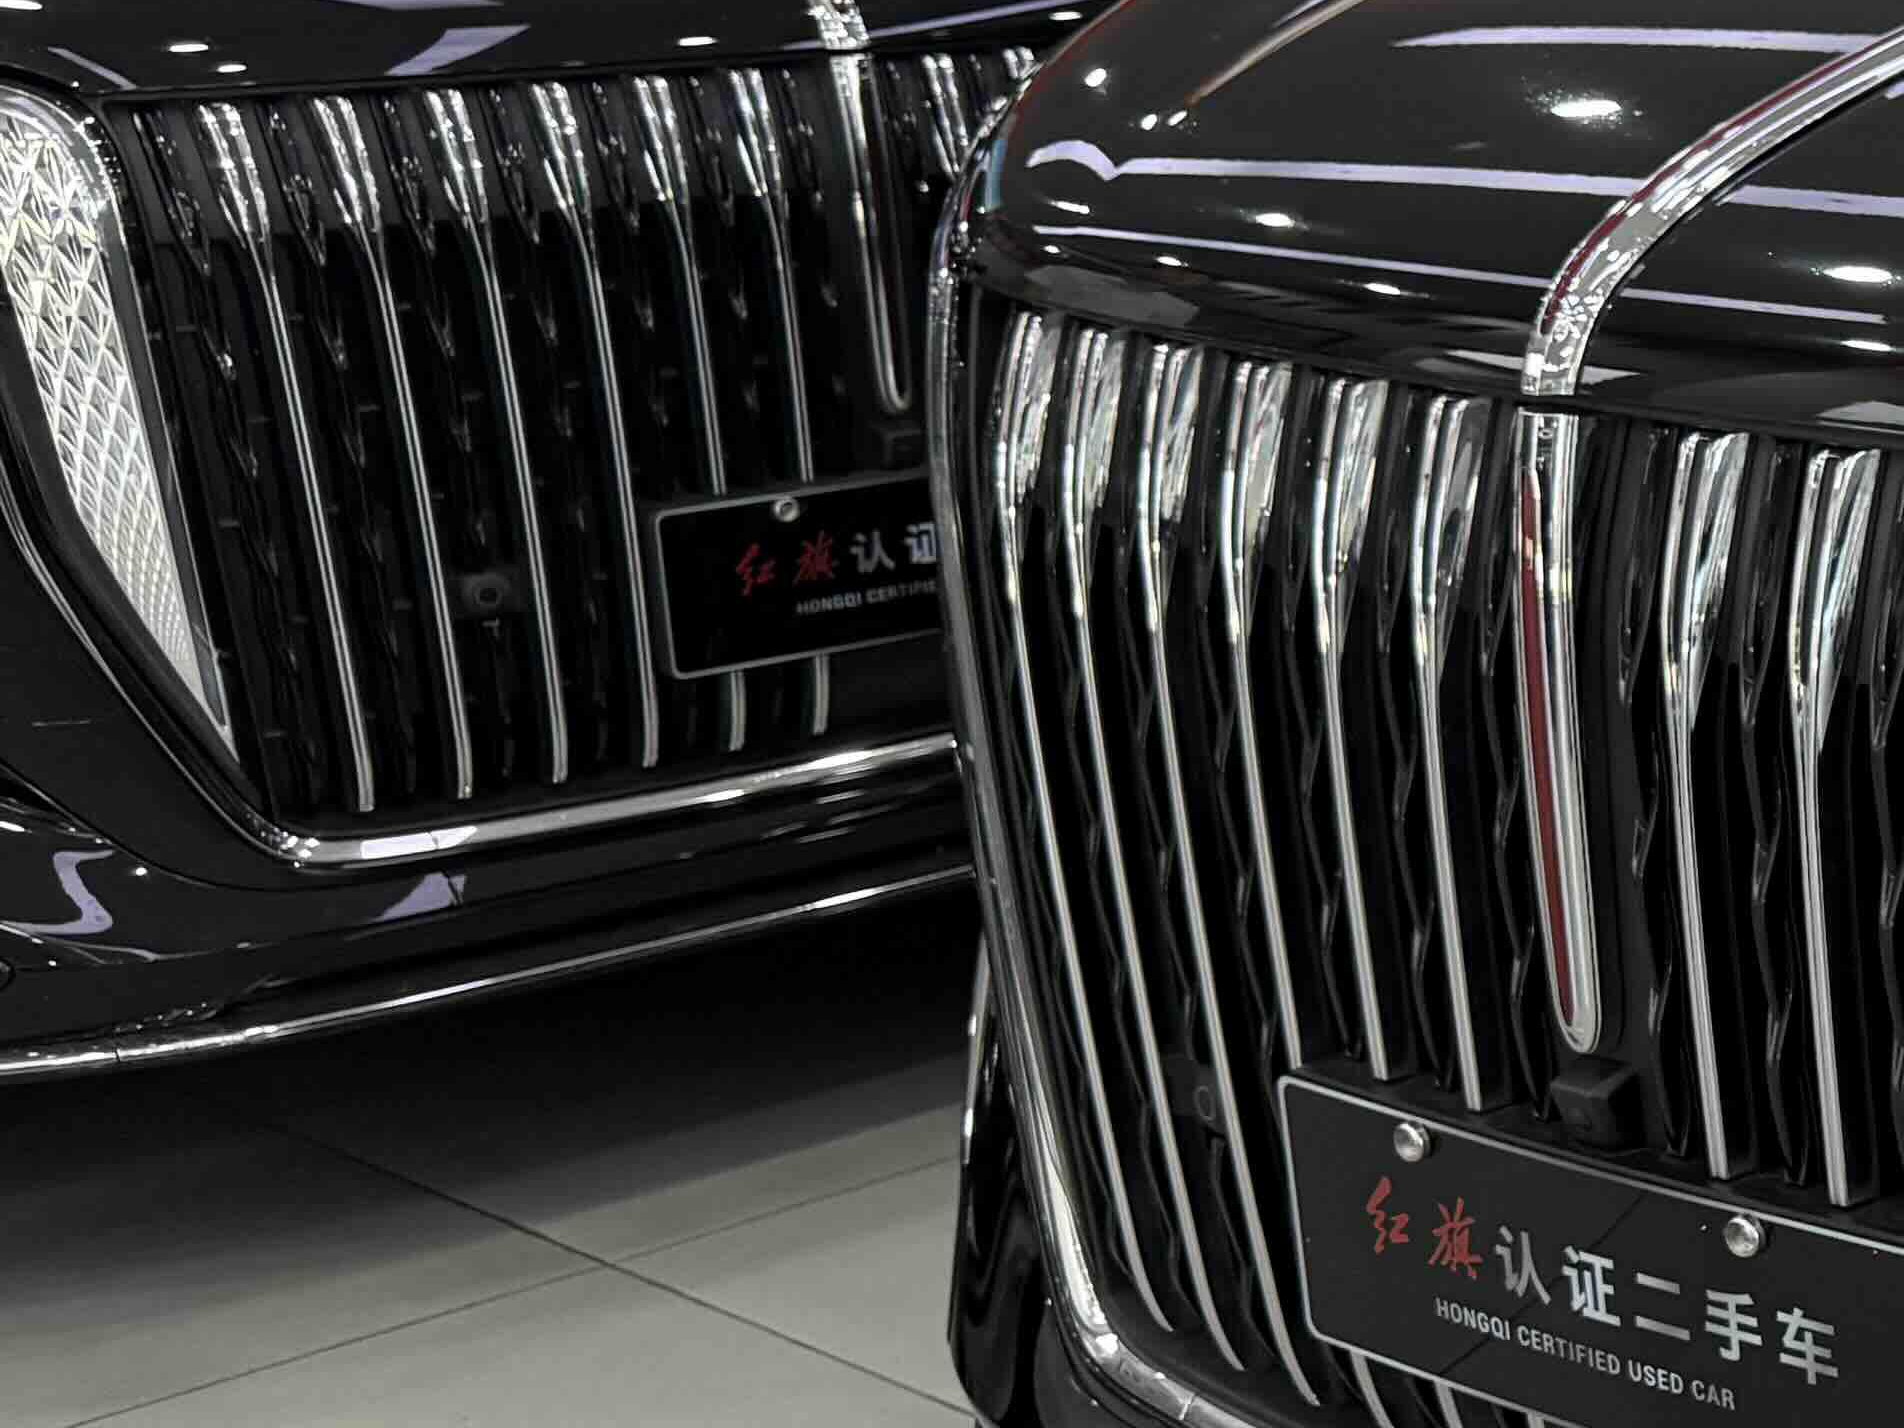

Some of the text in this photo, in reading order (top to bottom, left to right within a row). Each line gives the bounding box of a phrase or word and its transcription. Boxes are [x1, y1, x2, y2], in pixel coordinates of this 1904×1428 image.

[1435, 1296, 1736, 1411] HONGQI CERTIFIED USED CAR
